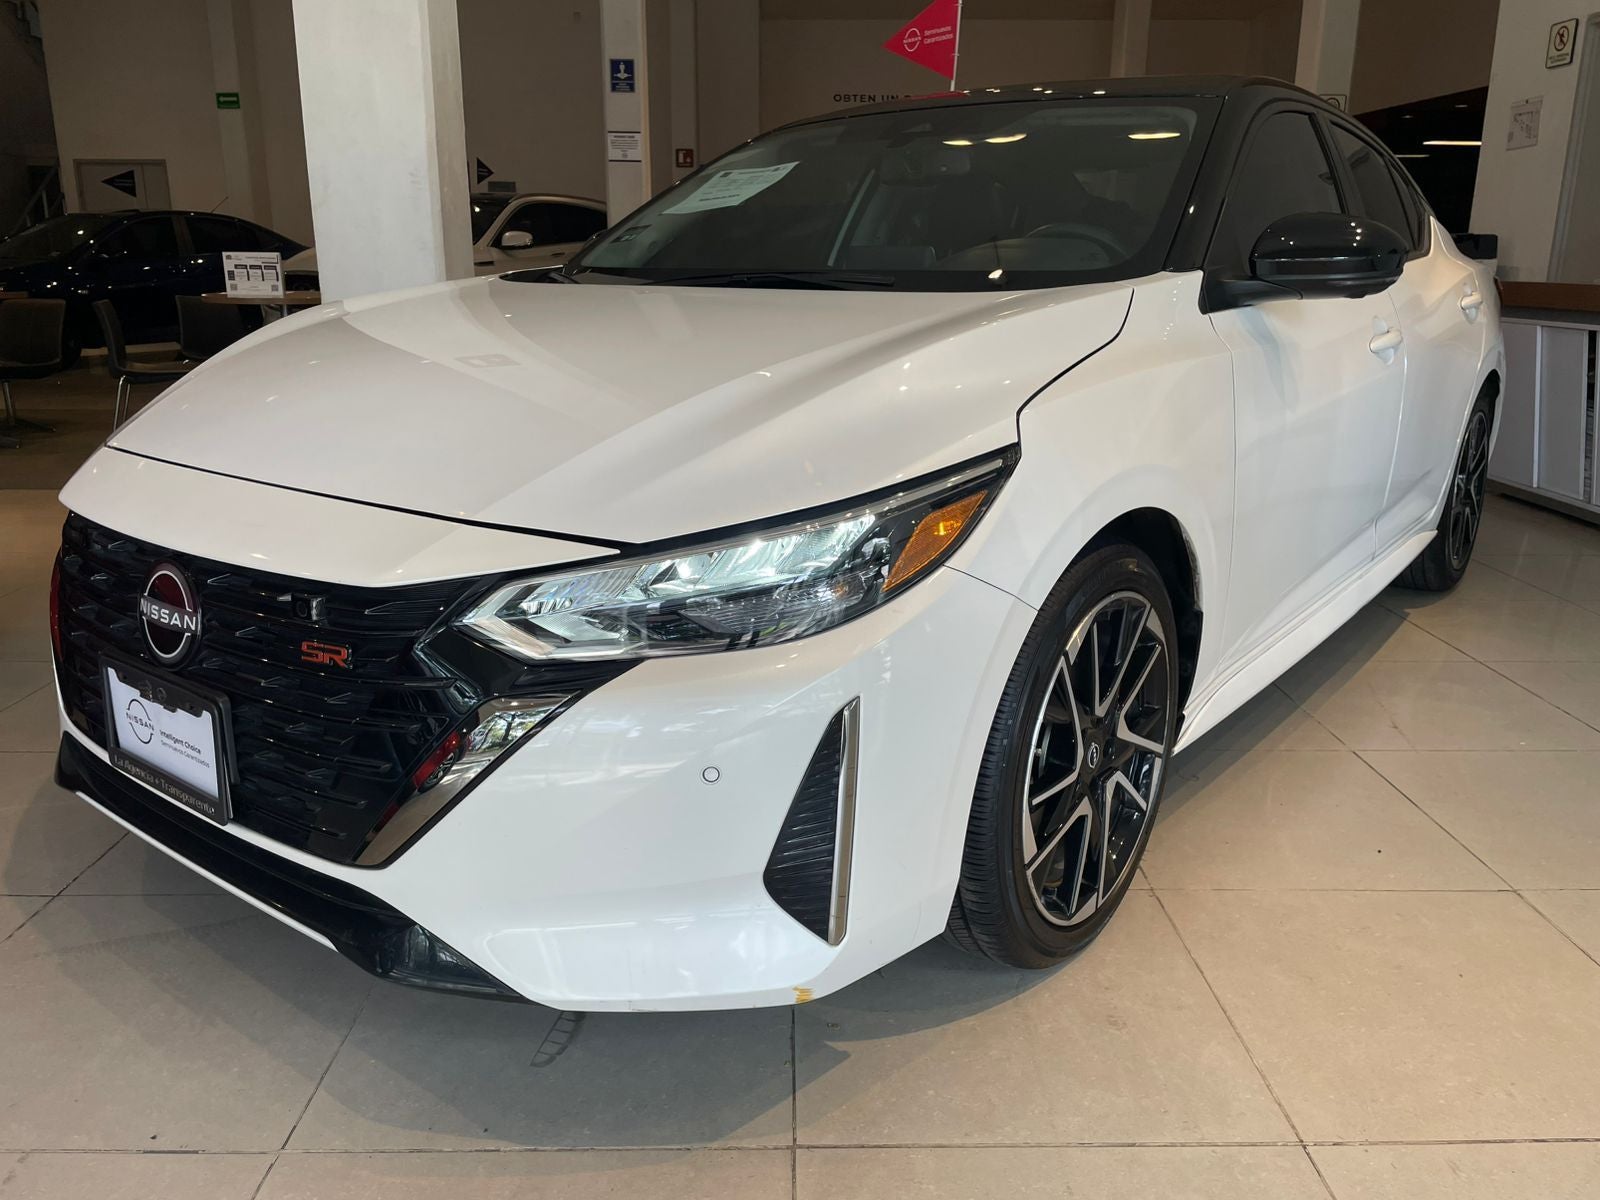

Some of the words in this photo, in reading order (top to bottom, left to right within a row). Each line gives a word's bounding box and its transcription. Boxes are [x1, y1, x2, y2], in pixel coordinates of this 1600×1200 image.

[833, 94, 876, 102] OBTEN
[140, 598, 196, 631] NISSAN
[301, 641, 352, 669] SR
[126, 712, 154, 731] NISSAN
[160, 729, 184, 746] Intelligent
[184, 741, 201, 754] Choice
